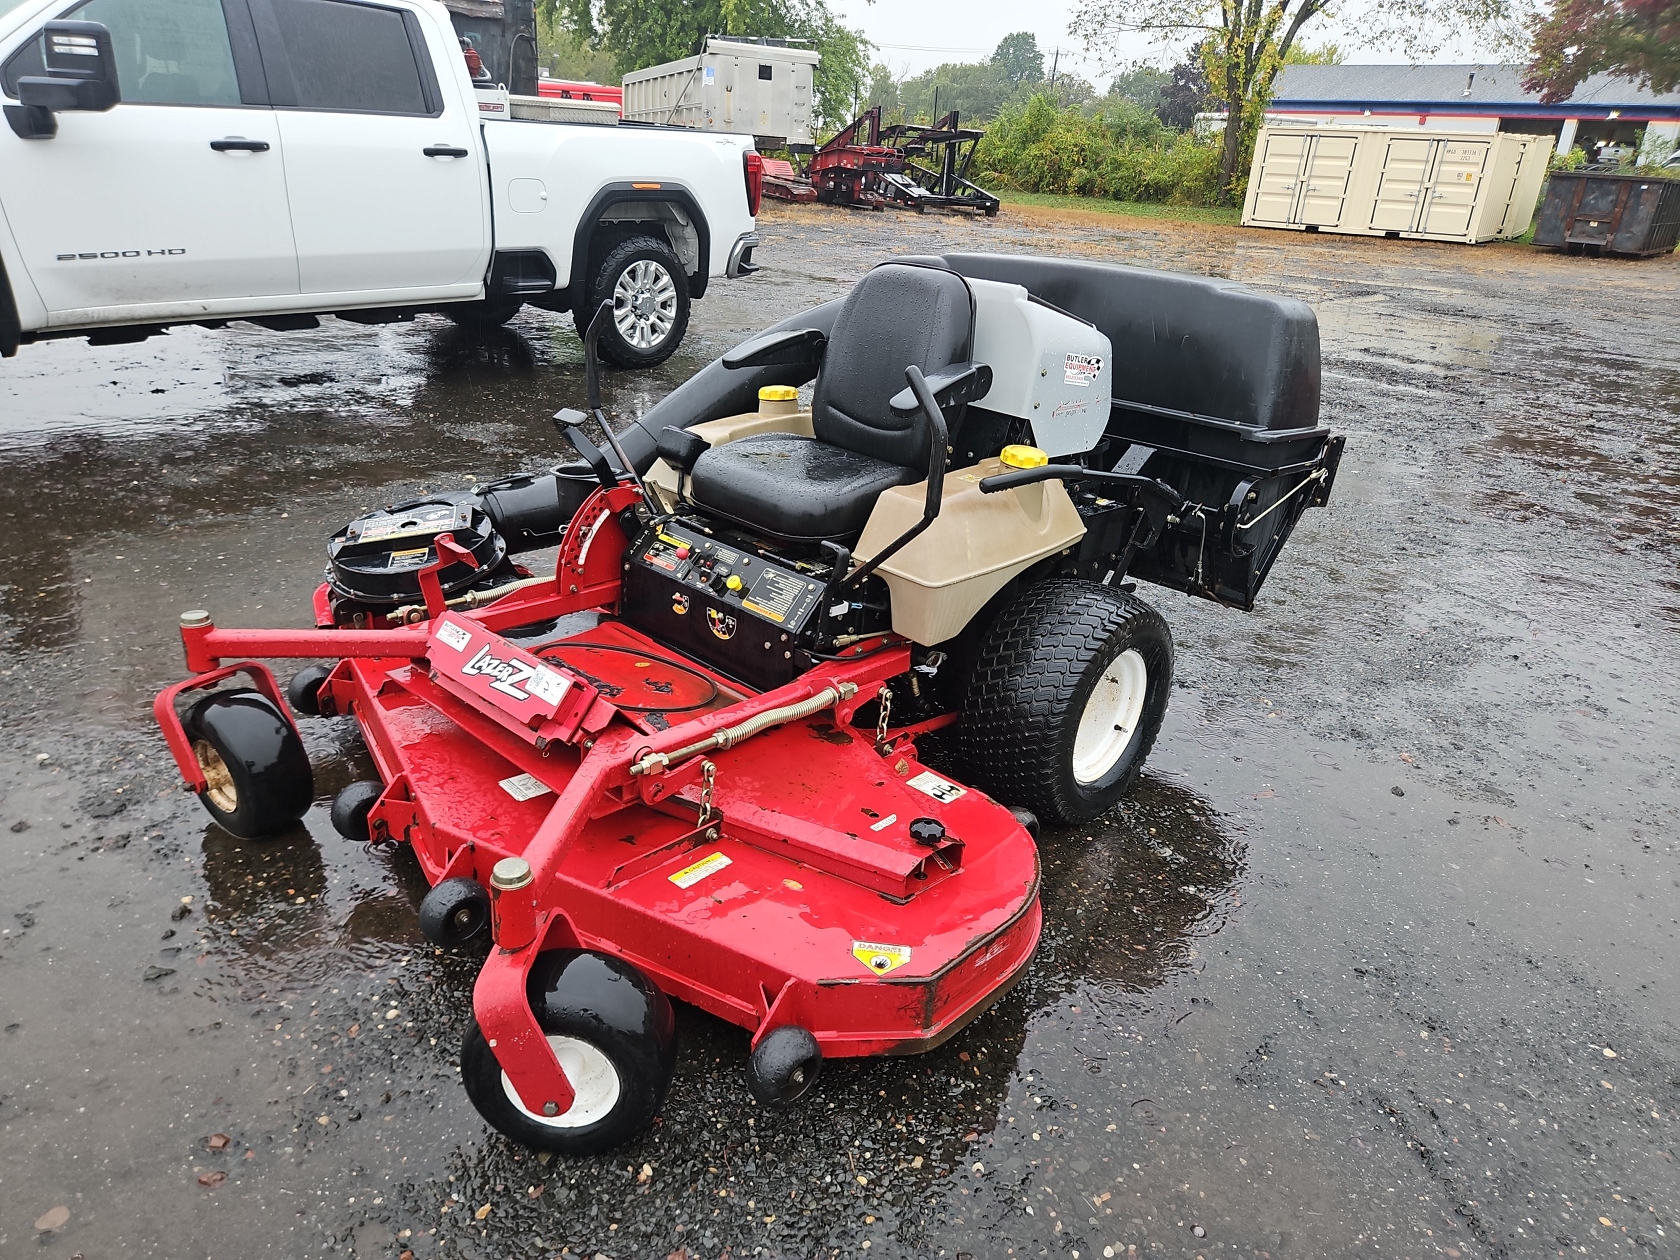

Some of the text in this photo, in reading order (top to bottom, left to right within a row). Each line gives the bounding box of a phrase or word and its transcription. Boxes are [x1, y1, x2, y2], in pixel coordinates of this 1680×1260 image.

[56, 248, 186, 261] 2500 HD
[1066, 354, 1089, 364] BUTLER
[1065, 362, 1096, 373] EQUIPMENT
[461, 643, 514, 682] LAZER
[489, 657, 536, 701] Z
